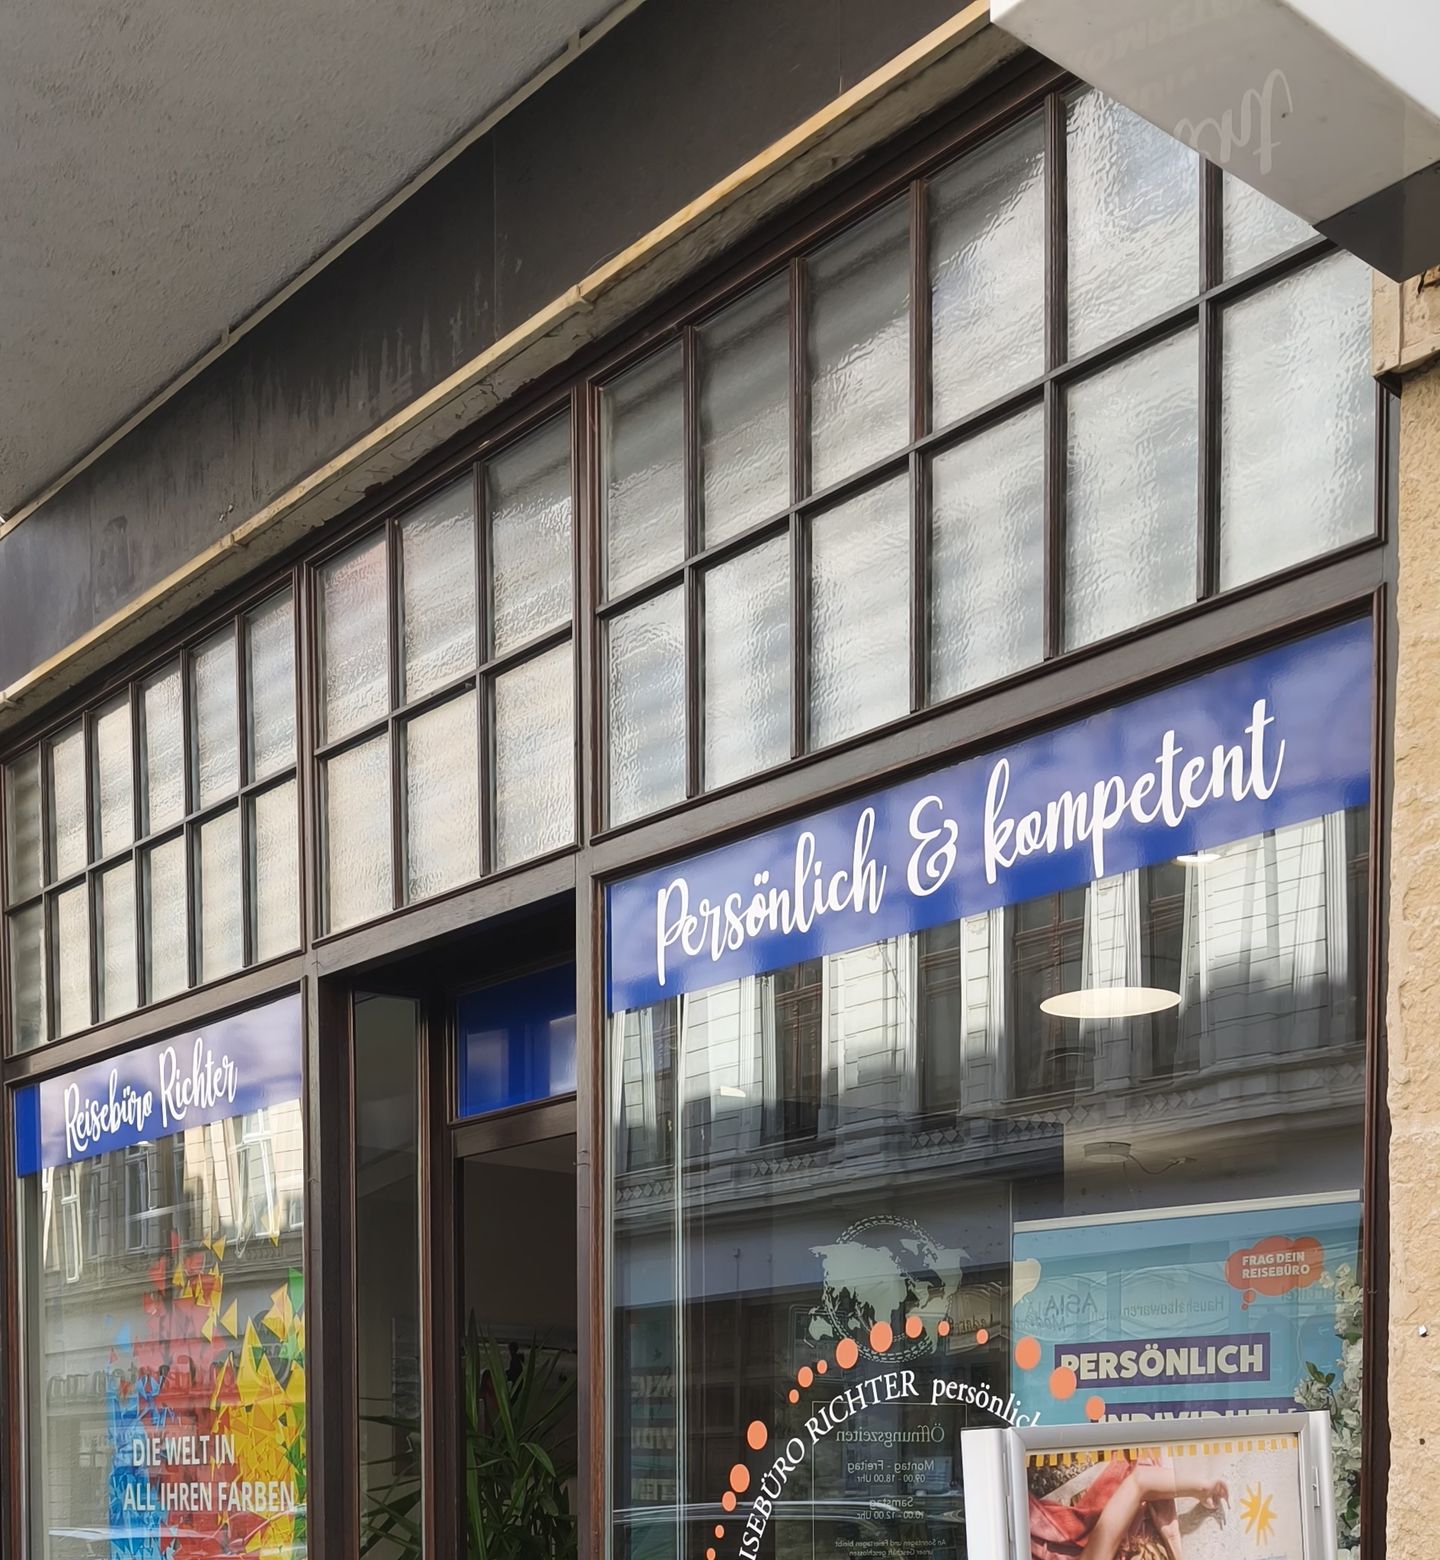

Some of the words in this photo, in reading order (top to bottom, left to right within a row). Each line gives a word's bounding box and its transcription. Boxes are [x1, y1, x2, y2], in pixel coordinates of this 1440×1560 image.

[656, 807, 887, 986] Persönlich
[907, 795, 958, 896] &
[982, 699, 1285, 883] kompetent
[64, 1069, 153, 1158] Reisebüro
[159, 1037, 238, 1128] Richter
[1242, 1254, 1274, 1266] FRAG
[1276, 1252, 1305, 1263] DEIN
[1242, 1264, 1310, 1279] REISEBÜRO
[1061, 1344, 1263, 1380] PERSÖNLICH
[804, 1370, 919, 1445] RICHTER
[132, 1438, 161, 1467] DIE
[165, 1435, 210, 1465] WELT
[214, 1434, 235, 1464] IN
[123, 1482, 156, 1511] ALL
[161, 1482, 212, 1511] IHREN
[218, 1481, 295, 1512] FARBEN
